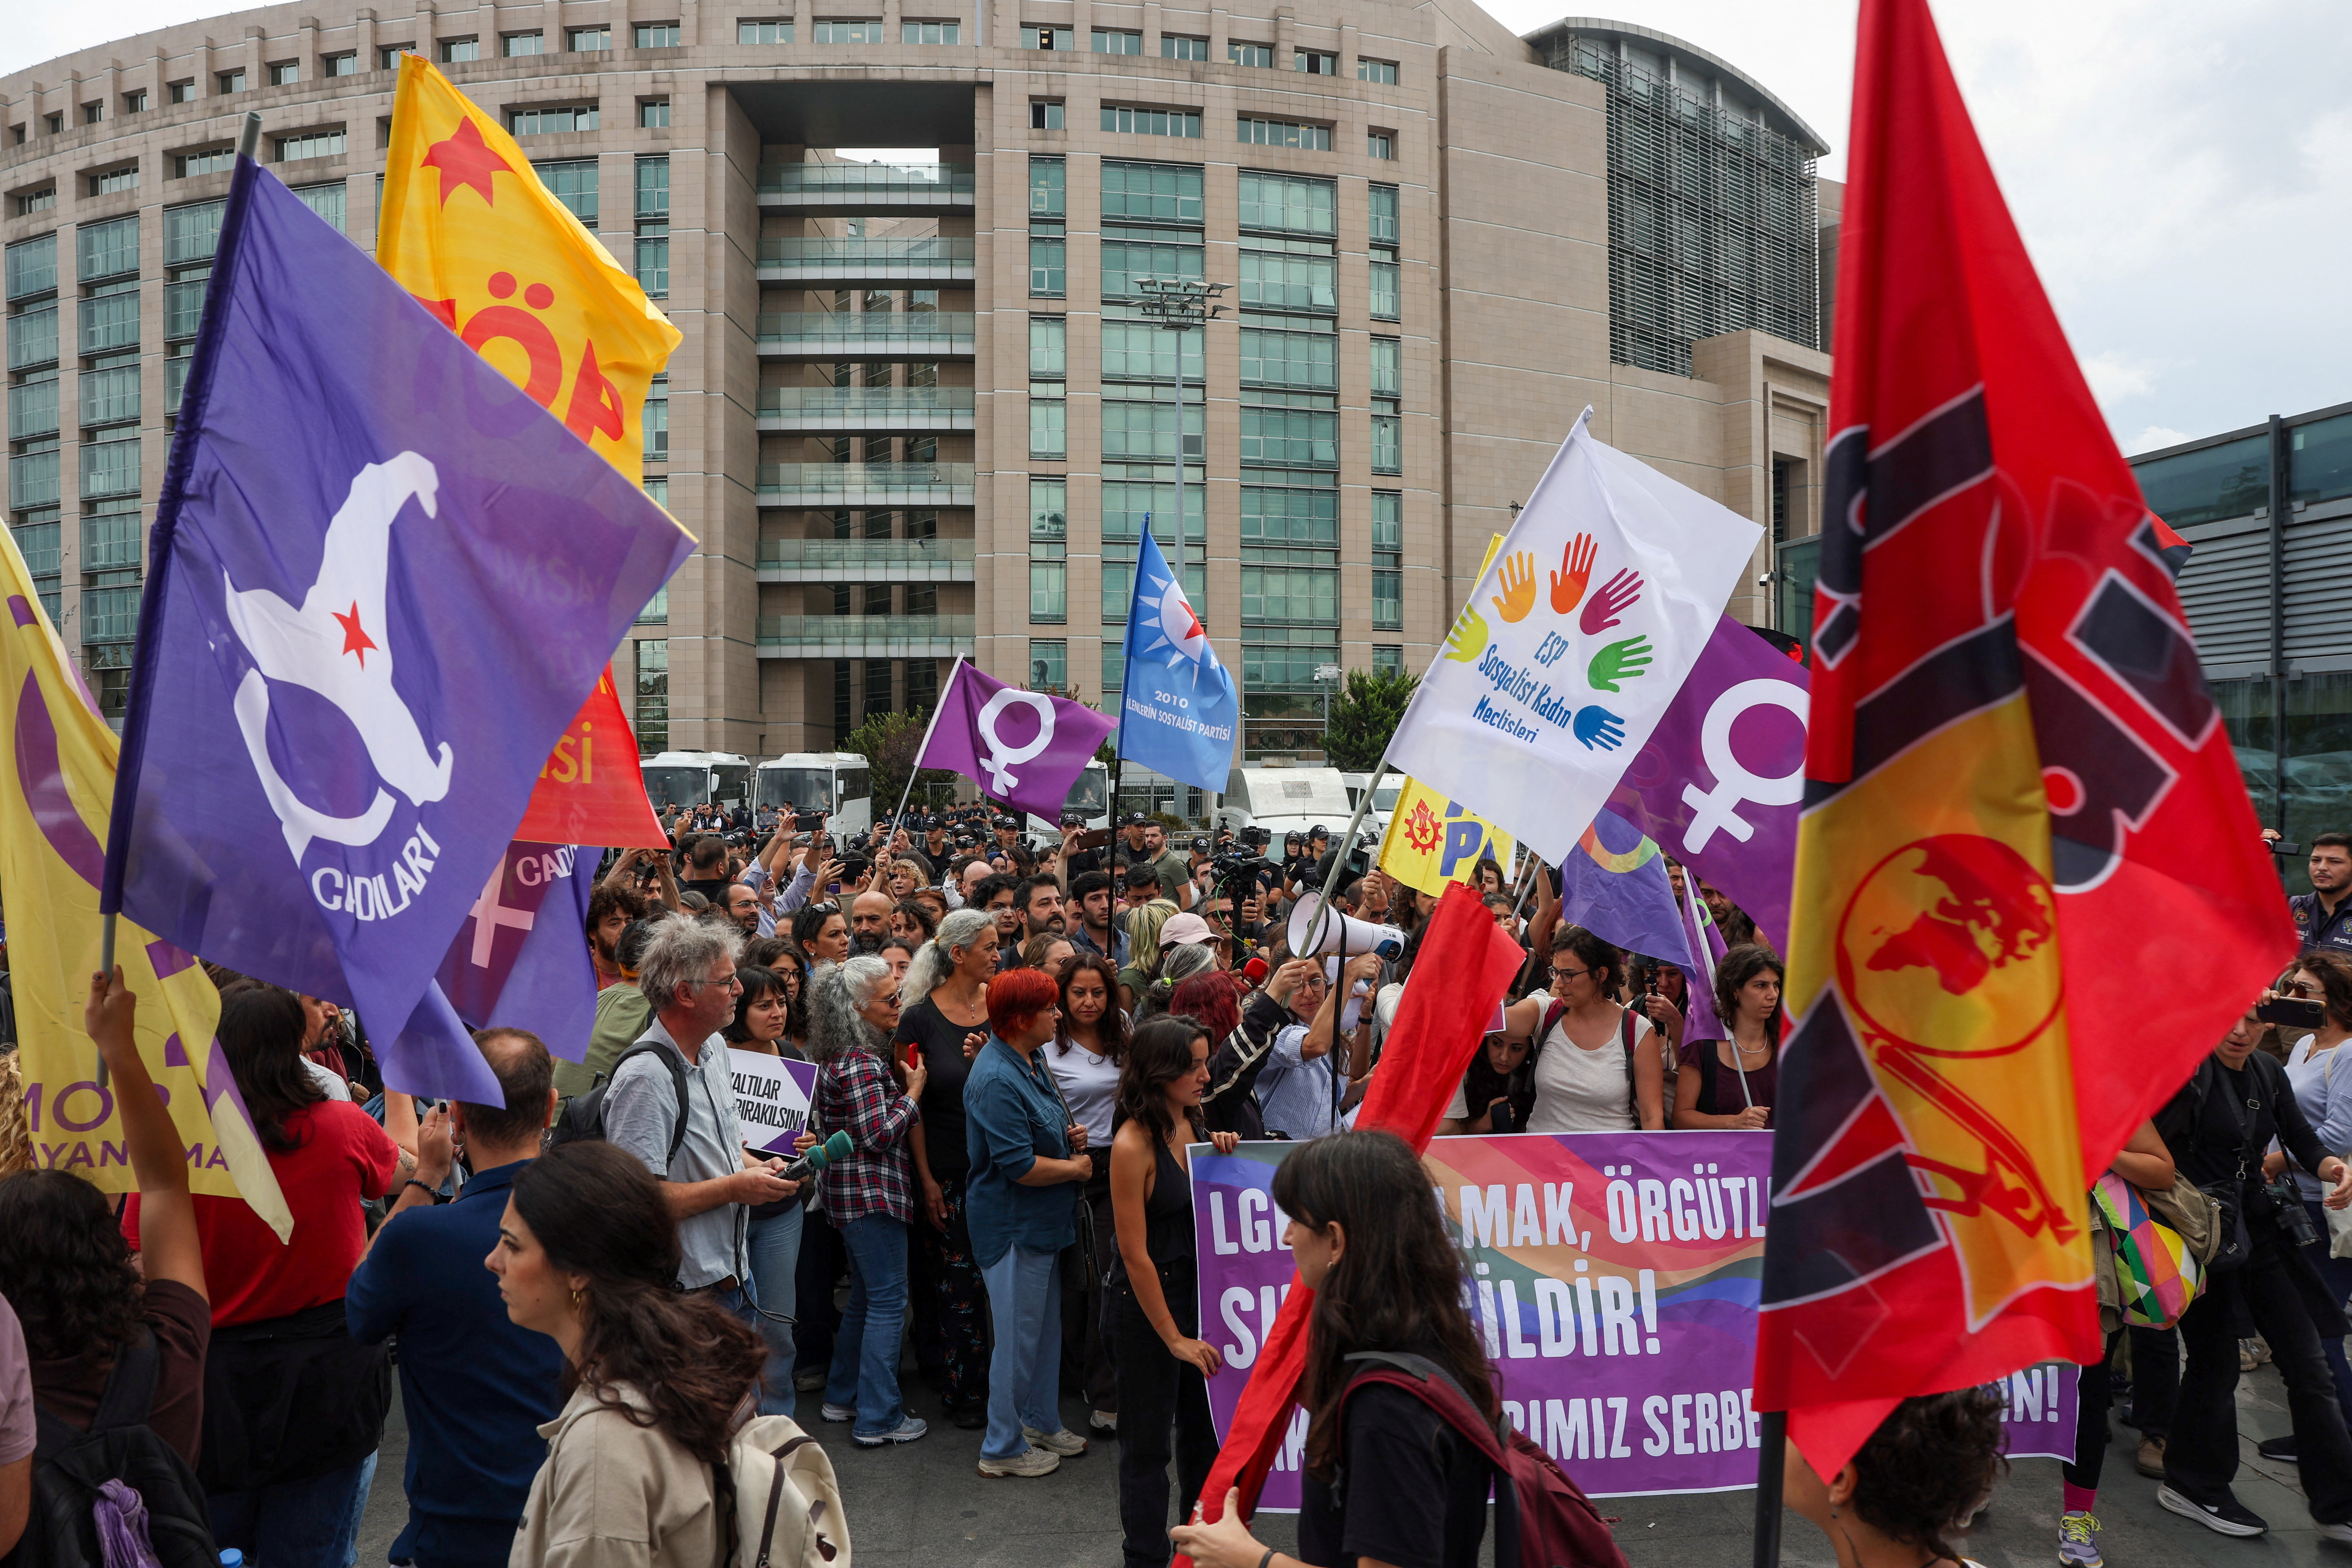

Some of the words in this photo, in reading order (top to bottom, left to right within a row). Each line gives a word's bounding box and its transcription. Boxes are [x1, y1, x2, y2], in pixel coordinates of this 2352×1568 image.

[1534, 630, 1569, 668] ESP
[1154, 690, 1189, 708] 2010
[1478, 644, 1539, 705] Sosyalist
[1530, 683, 1572, 729] Kadın
[1158, 710, 1198, 733] SOSYALİST
[1198, 722, 1231, 741] PARTİSİ
[1472, 694, 1540, 744] Meclisleri
[539, 721, 592, 784] Sİ
[312, 822, 441, 921] CADILARI
